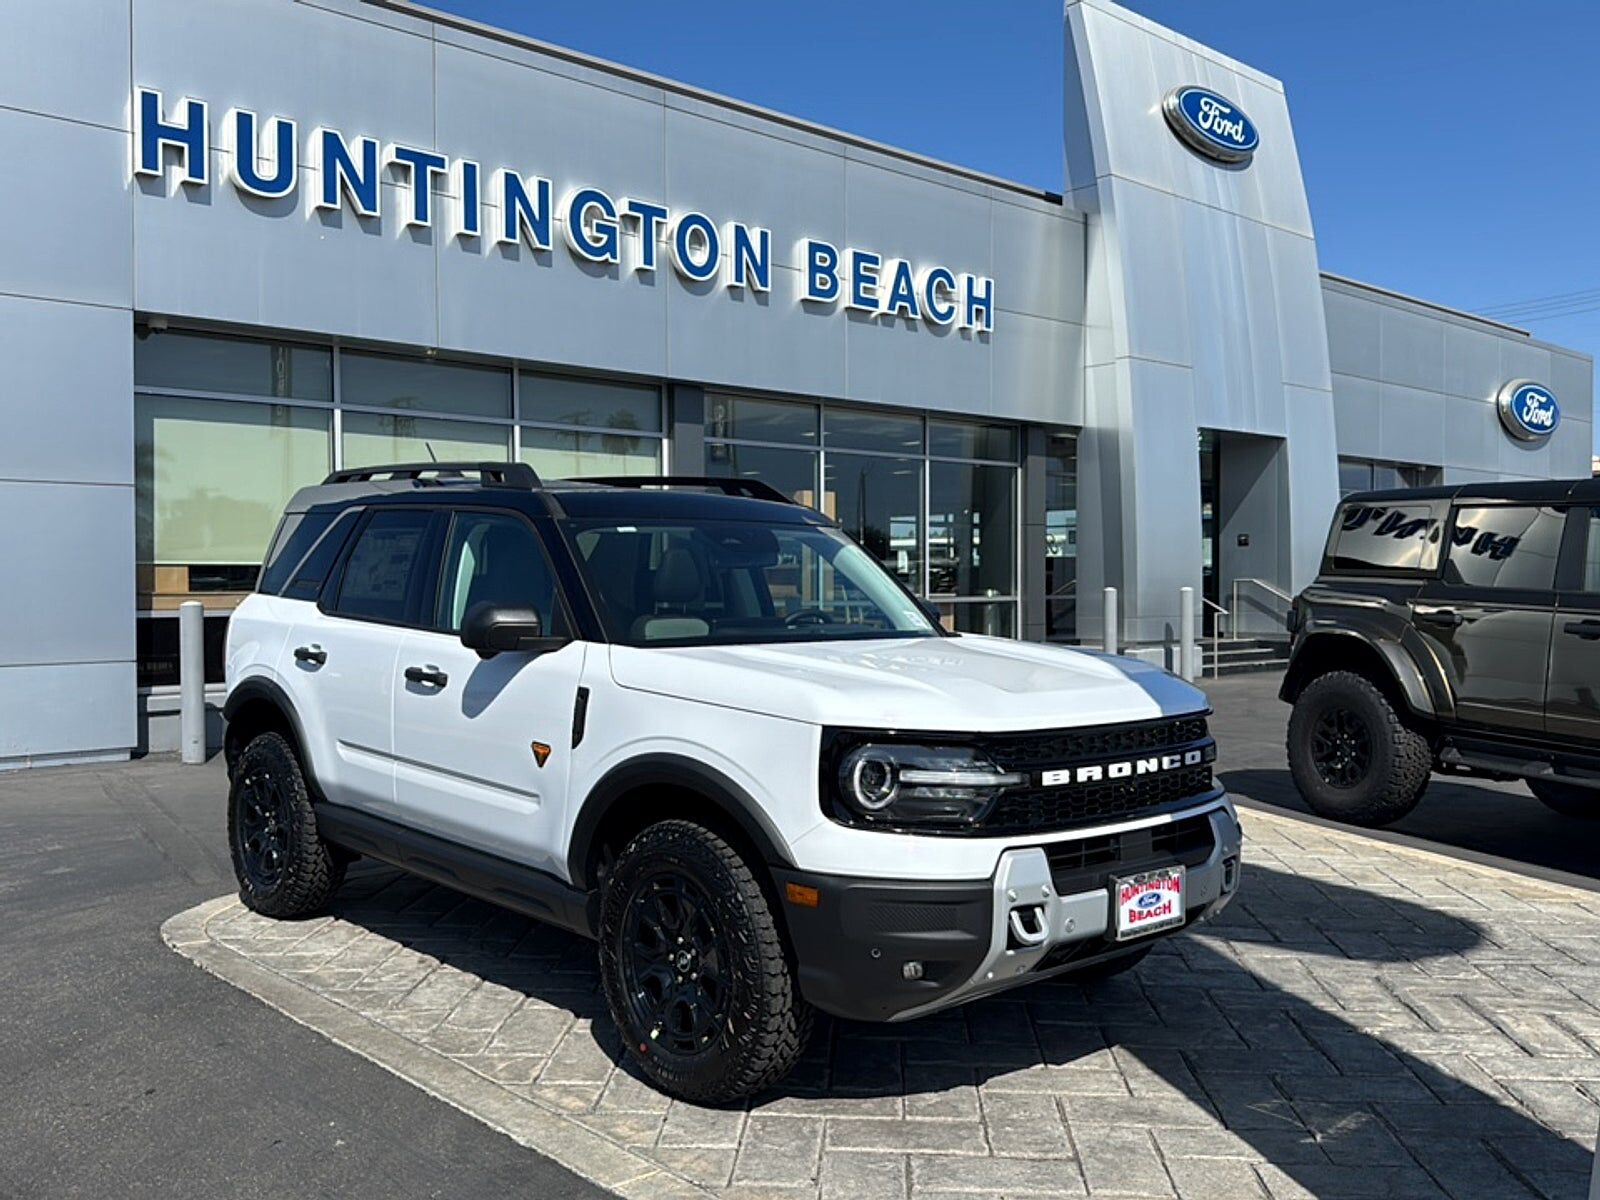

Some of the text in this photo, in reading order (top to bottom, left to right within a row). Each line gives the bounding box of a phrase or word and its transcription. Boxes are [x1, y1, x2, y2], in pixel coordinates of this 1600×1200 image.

[1198, 97, 1245, 143] Ford
[135, 87, 994, 332] HUNTINGTON BEACH
[1523, 391, 1554, 427] Ford
[1041, 750, 1202, 787] BRONCO
[1120, 875, 1182, 907] HUNTINGTON
[1128, 899, 1172, 924] BEACH
